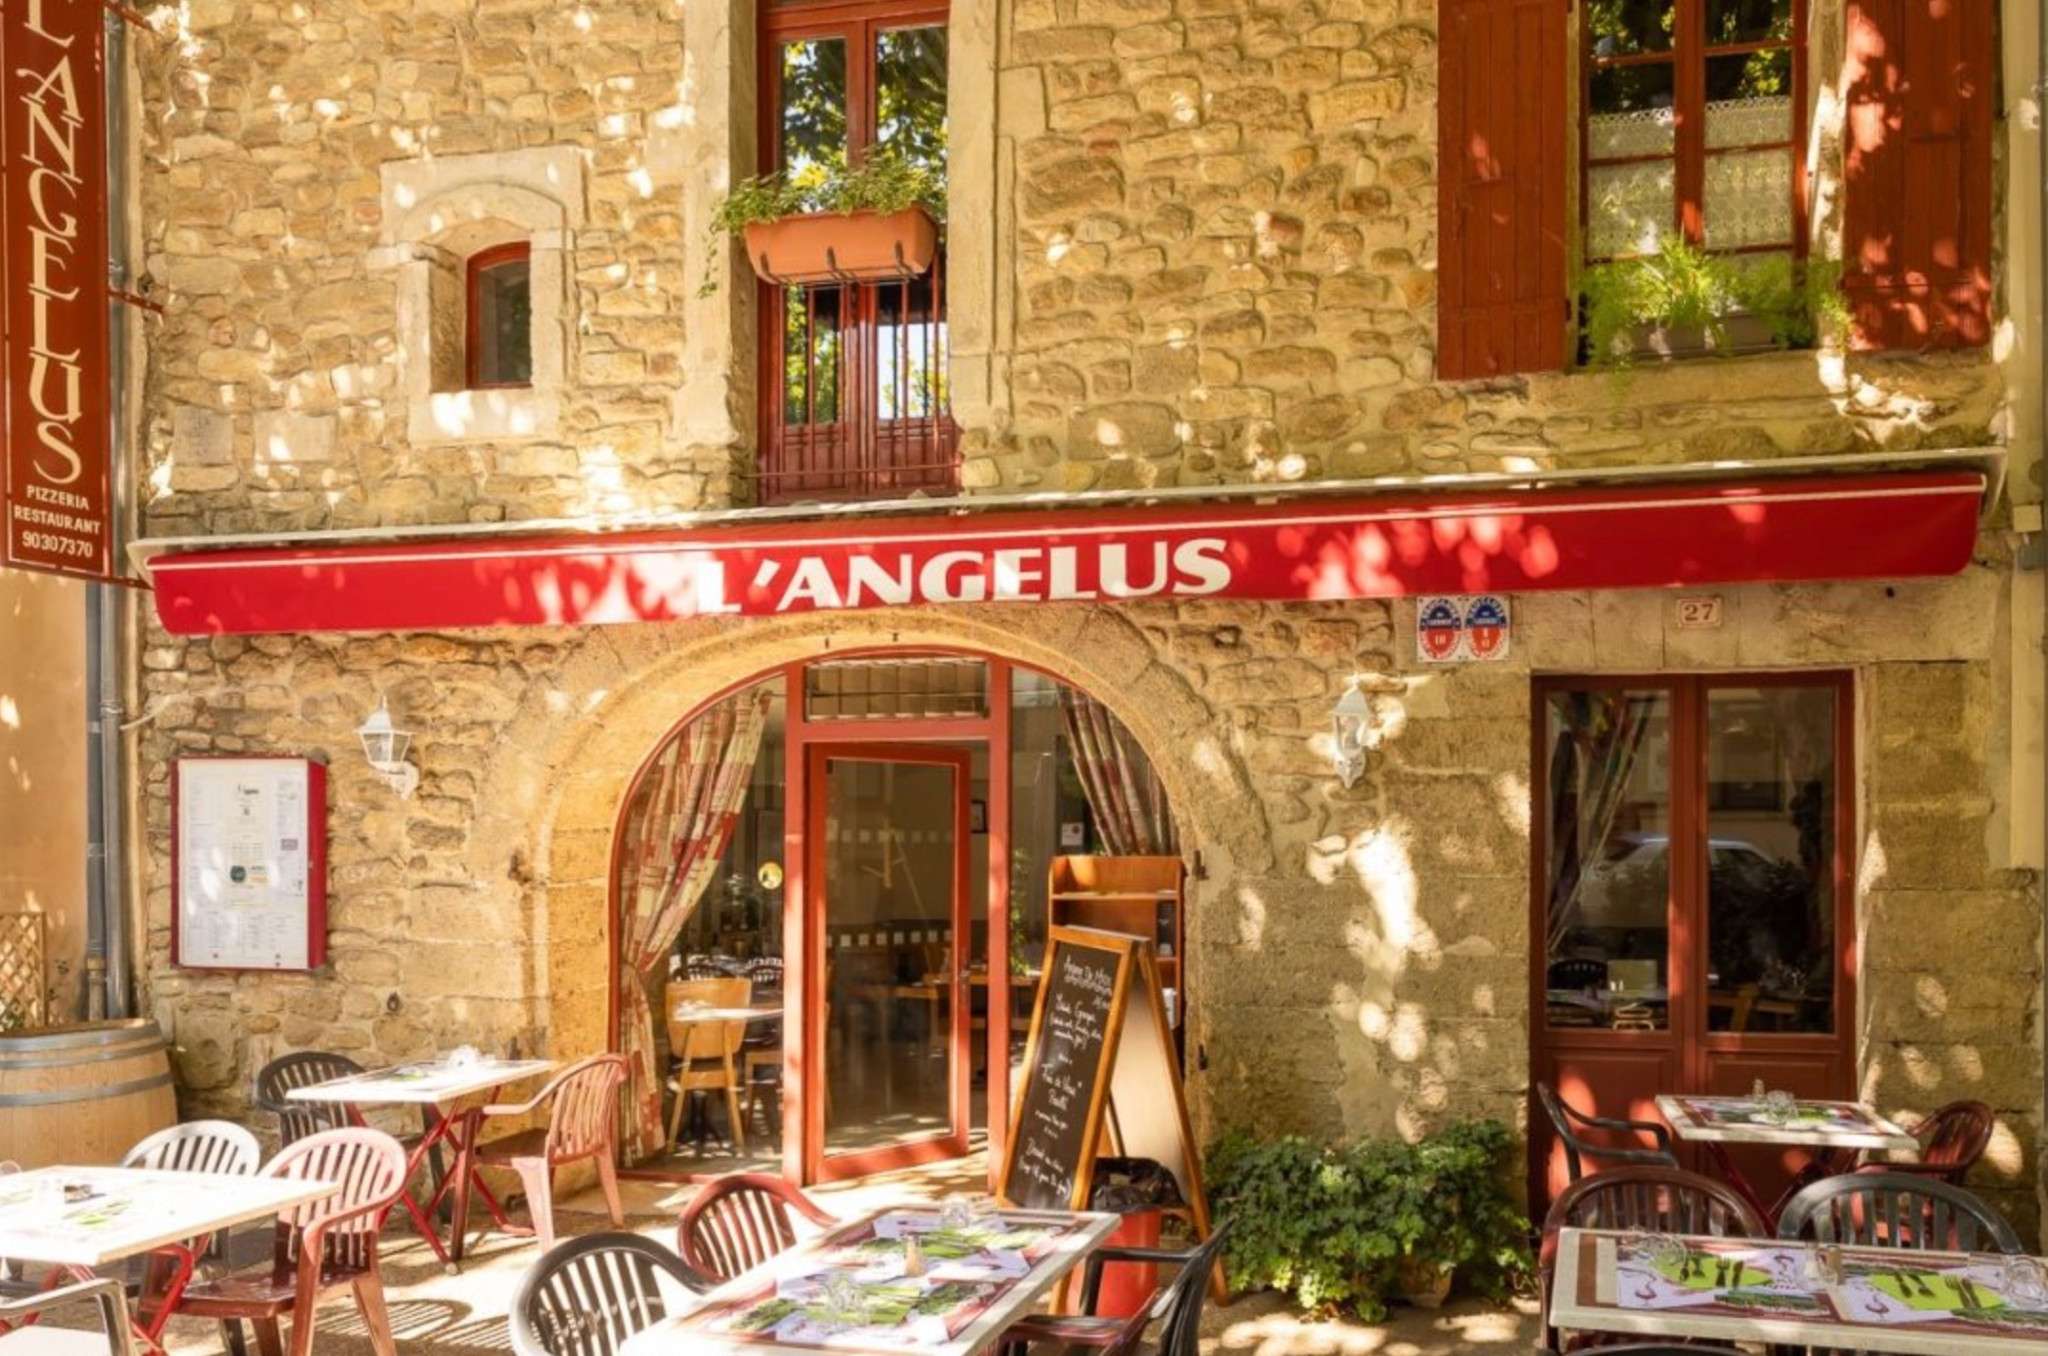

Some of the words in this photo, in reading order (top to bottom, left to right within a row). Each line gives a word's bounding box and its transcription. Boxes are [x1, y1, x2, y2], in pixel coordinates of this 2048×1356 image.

[26, 484, 90, 511] PIZZERIA
[13, 504, 101, 535] RESTAURANT
[22, 530, 94, 558] 90307370
[697, 538, 1232, 614] L'ANGELUS
[1684, 603, 1713, 621] 27
